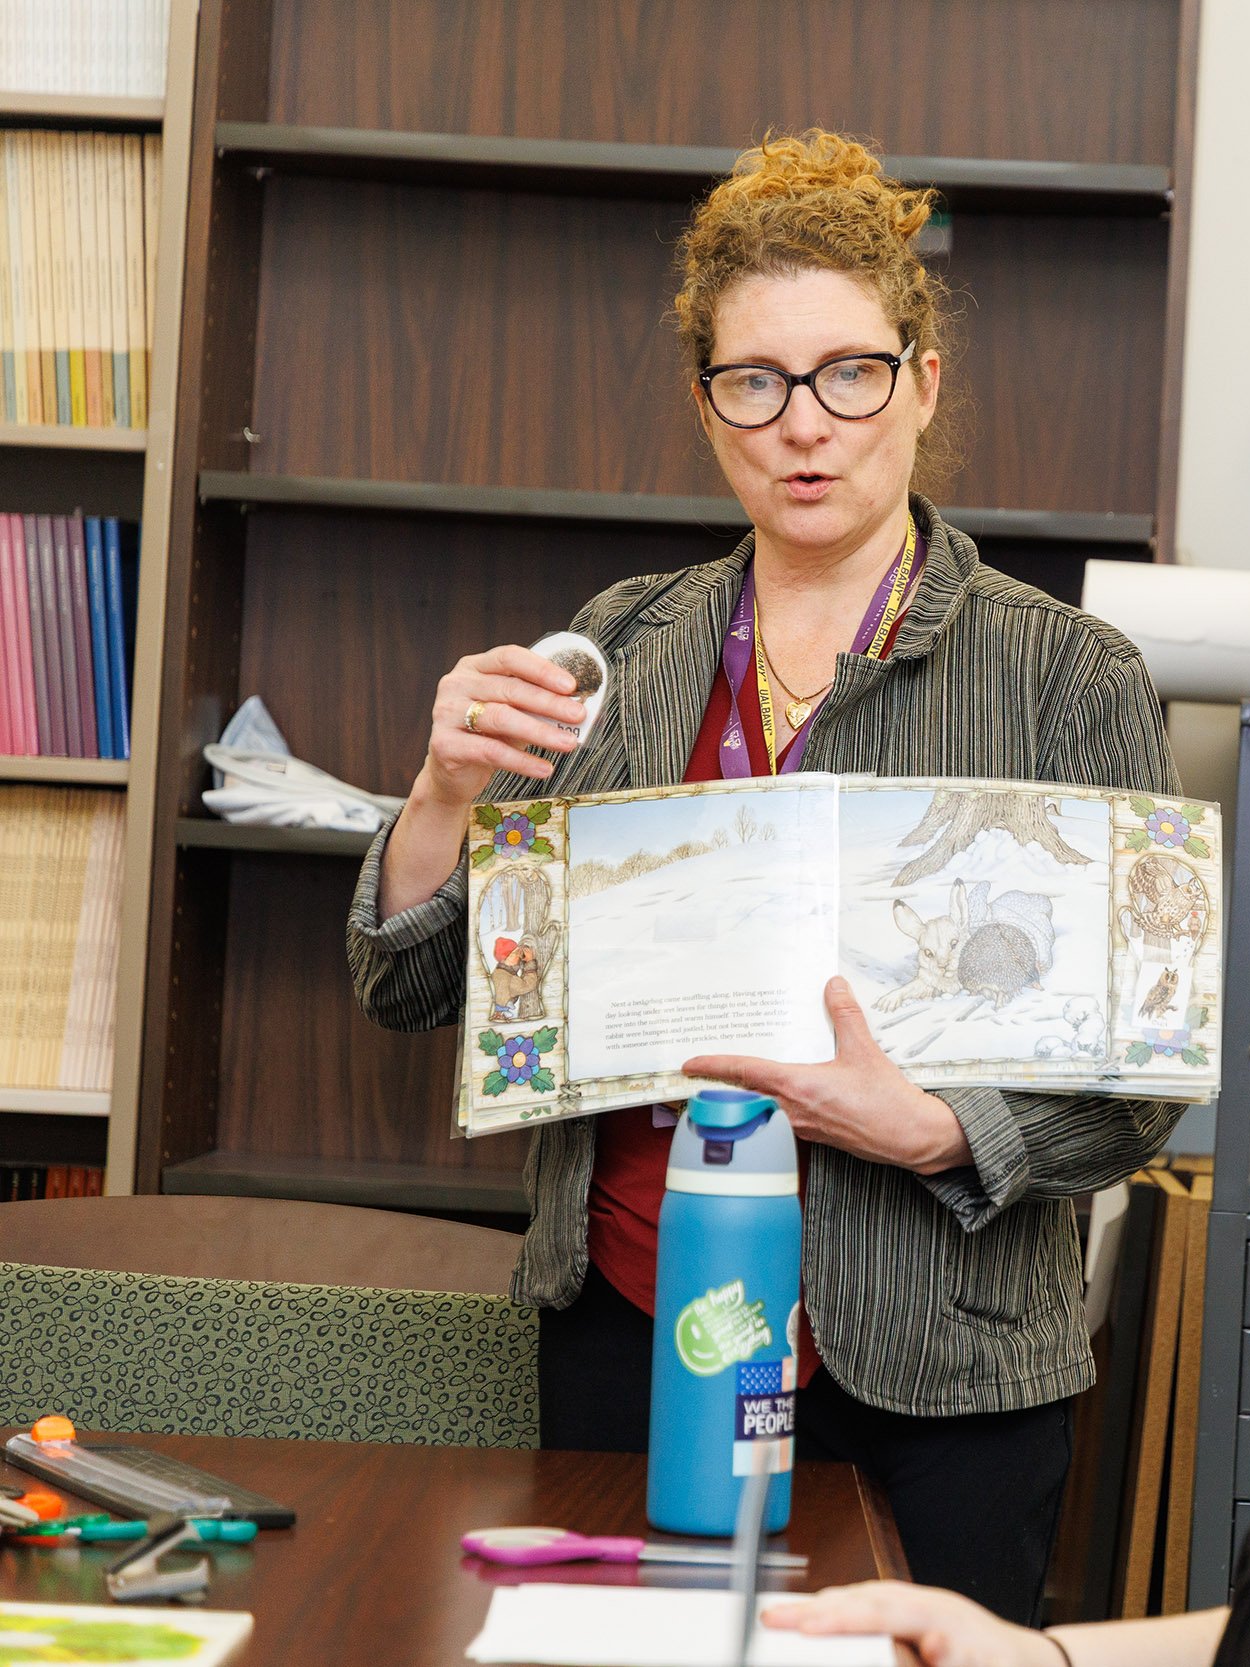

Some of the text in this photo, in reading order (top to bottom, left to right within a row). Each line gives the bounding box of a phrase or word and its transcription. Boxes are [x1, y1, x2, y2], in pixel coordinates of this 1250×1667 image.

[869, 607, 896, 657] UALBANY
[759, 689, 772, 733] UALBANY
[744, 1396, 795, 1414] WE THE
[744, 1411, 795, 1435] PEOPLE
